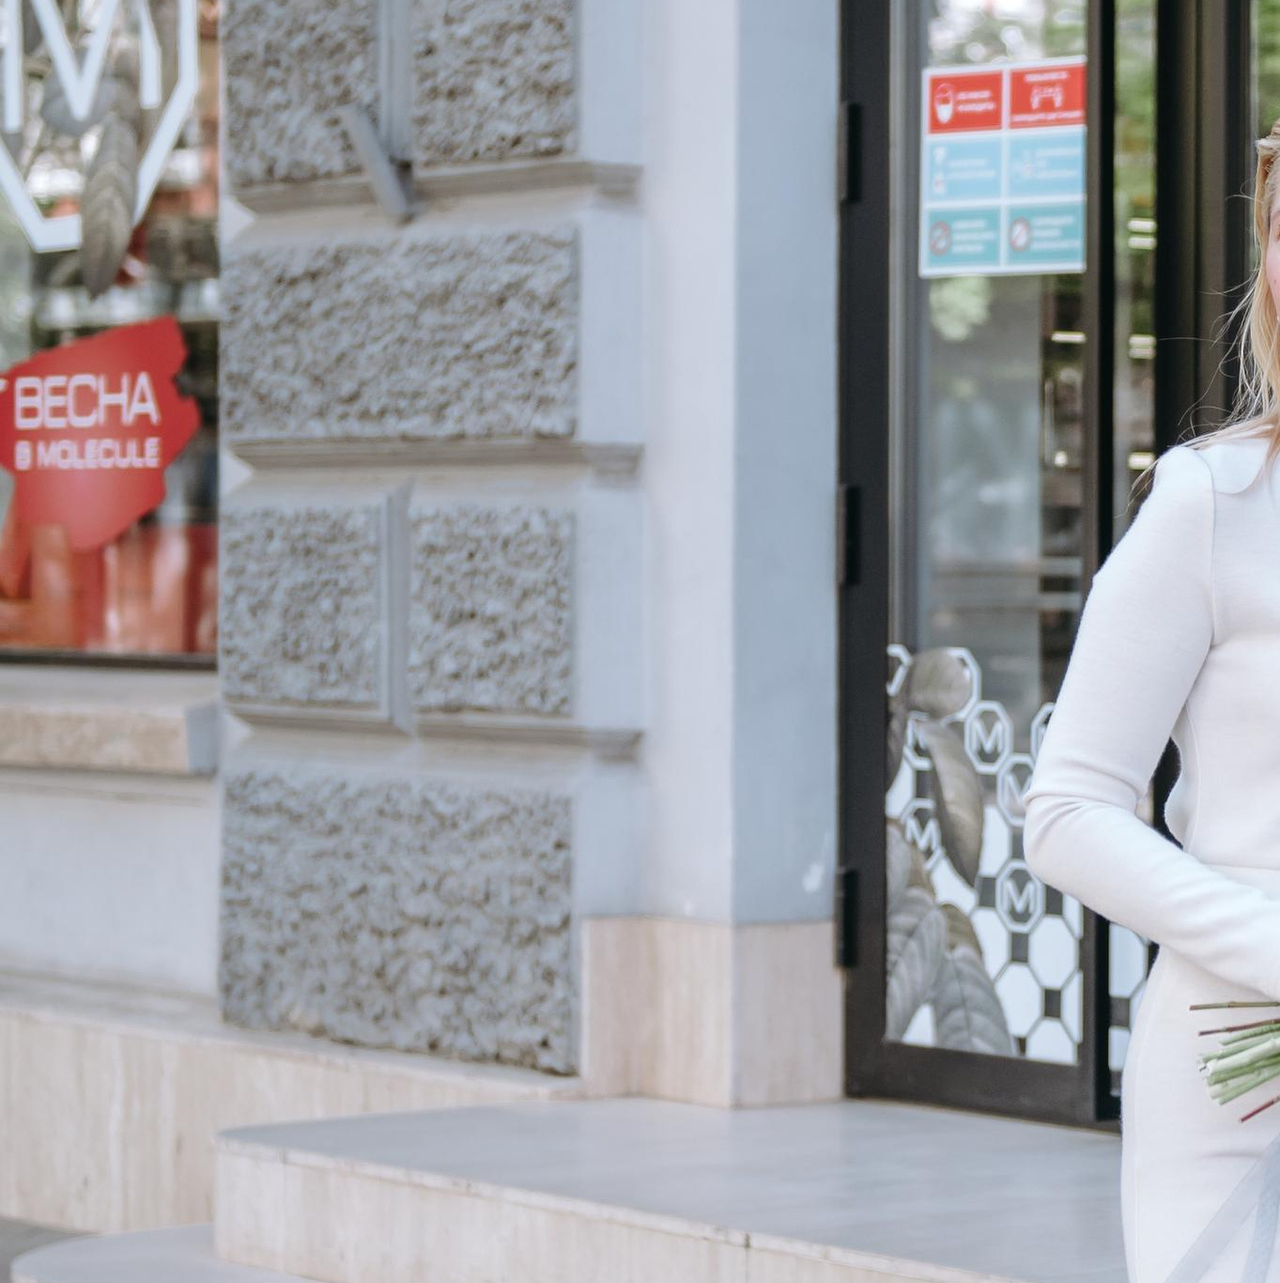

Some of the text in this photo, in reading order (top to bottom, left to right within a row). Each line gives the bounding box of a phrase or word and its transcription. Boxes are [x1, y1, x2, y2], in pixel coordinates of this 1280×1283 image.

[14, 372, 160, 430] ВЕСНА
[36, 436, 161, 469] MOLECULE
[971, 719, 1003, 753] M
[1005, 879, 1035, 915] M
